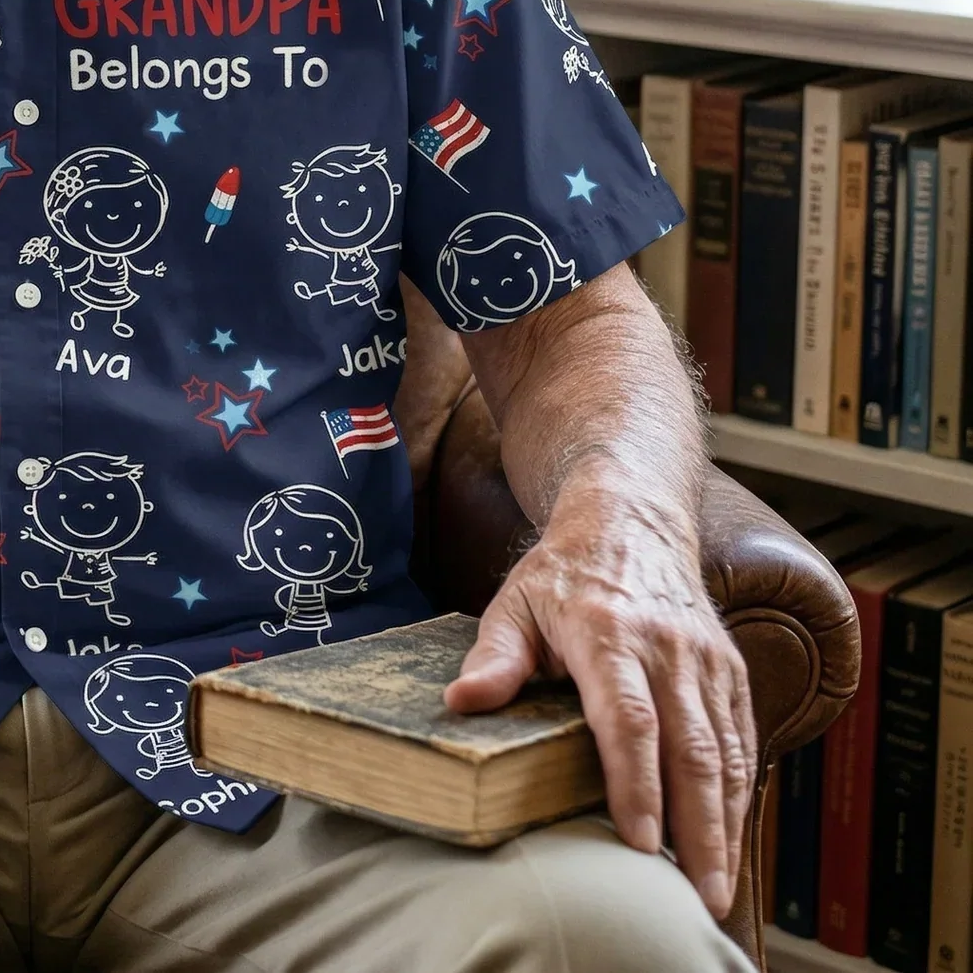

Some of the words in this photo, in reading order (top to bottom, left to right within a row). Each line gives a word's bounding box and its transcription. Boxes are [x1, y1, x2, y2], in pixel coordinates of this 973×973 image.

[69, 44, 252, 101] Belongs
[272, 45, 329, 88] To
[54, 338, 131, 381] Ava
